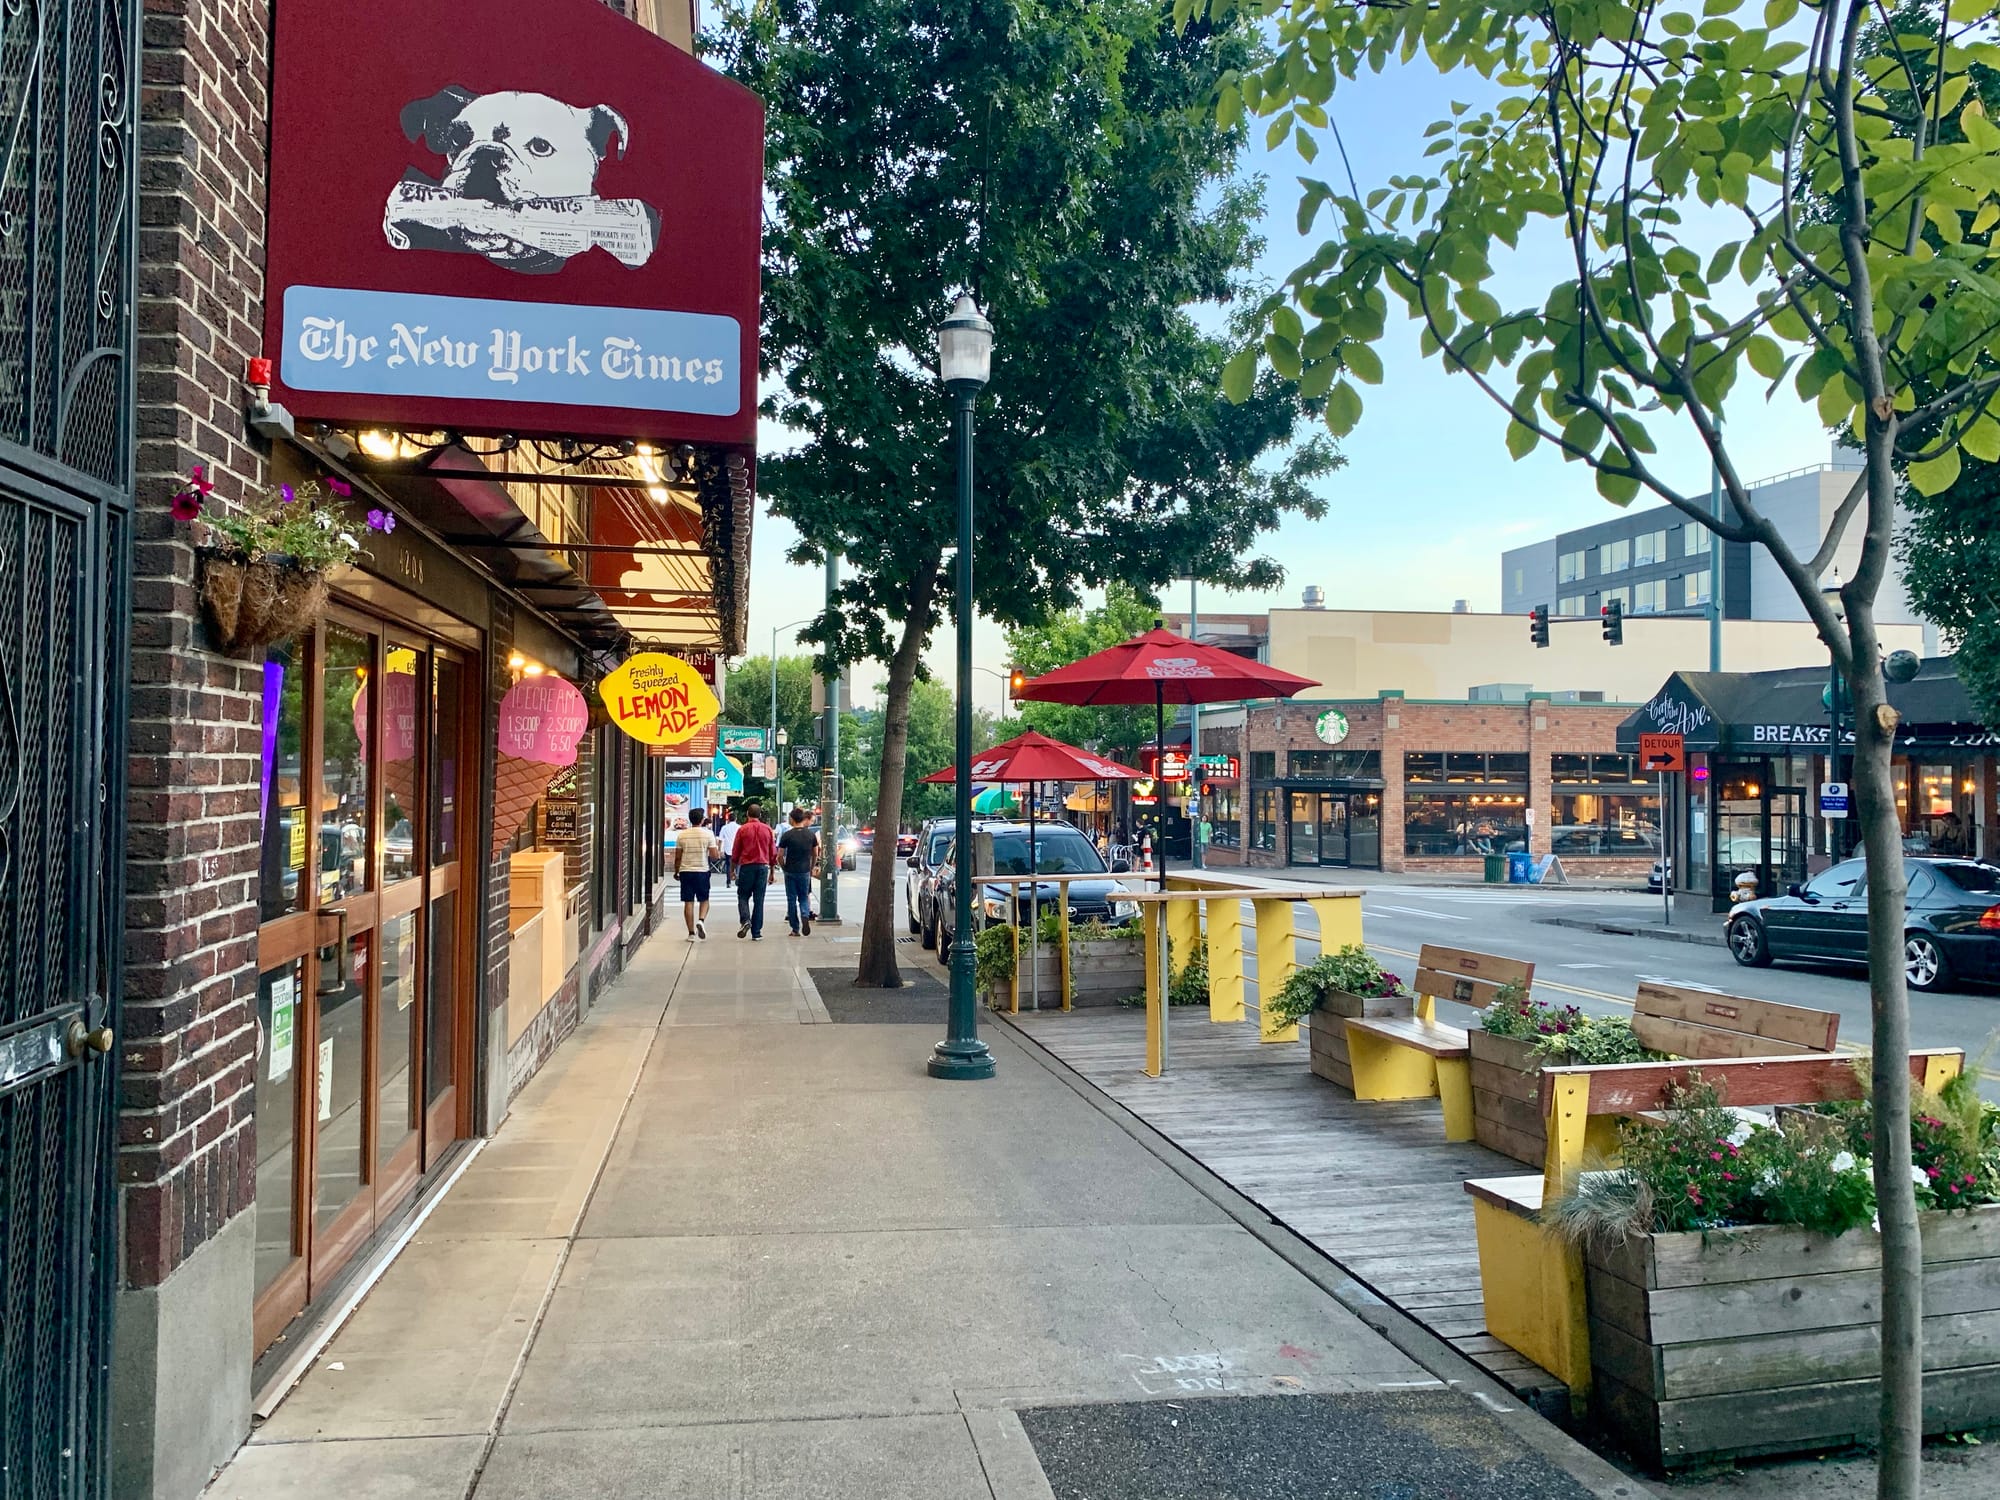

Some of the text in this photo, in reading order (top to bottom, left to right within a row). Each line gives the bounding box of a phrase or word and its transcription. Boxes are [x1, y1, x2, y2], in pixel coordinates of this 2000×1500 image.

[299, 316, 724, 386] The New York Times
[629, 664, 664, 679] Freshly
[632, 673, 680, 693] Squeezed
[618, 682, 689, 721] LEMON
[514, 715, 541, 733] SCOOP
[546, 716, 584, 733] 2 SCOOPS
[656, 707, 700, 737] ADE
[1644, 739, 1681, 749] DETOUR
